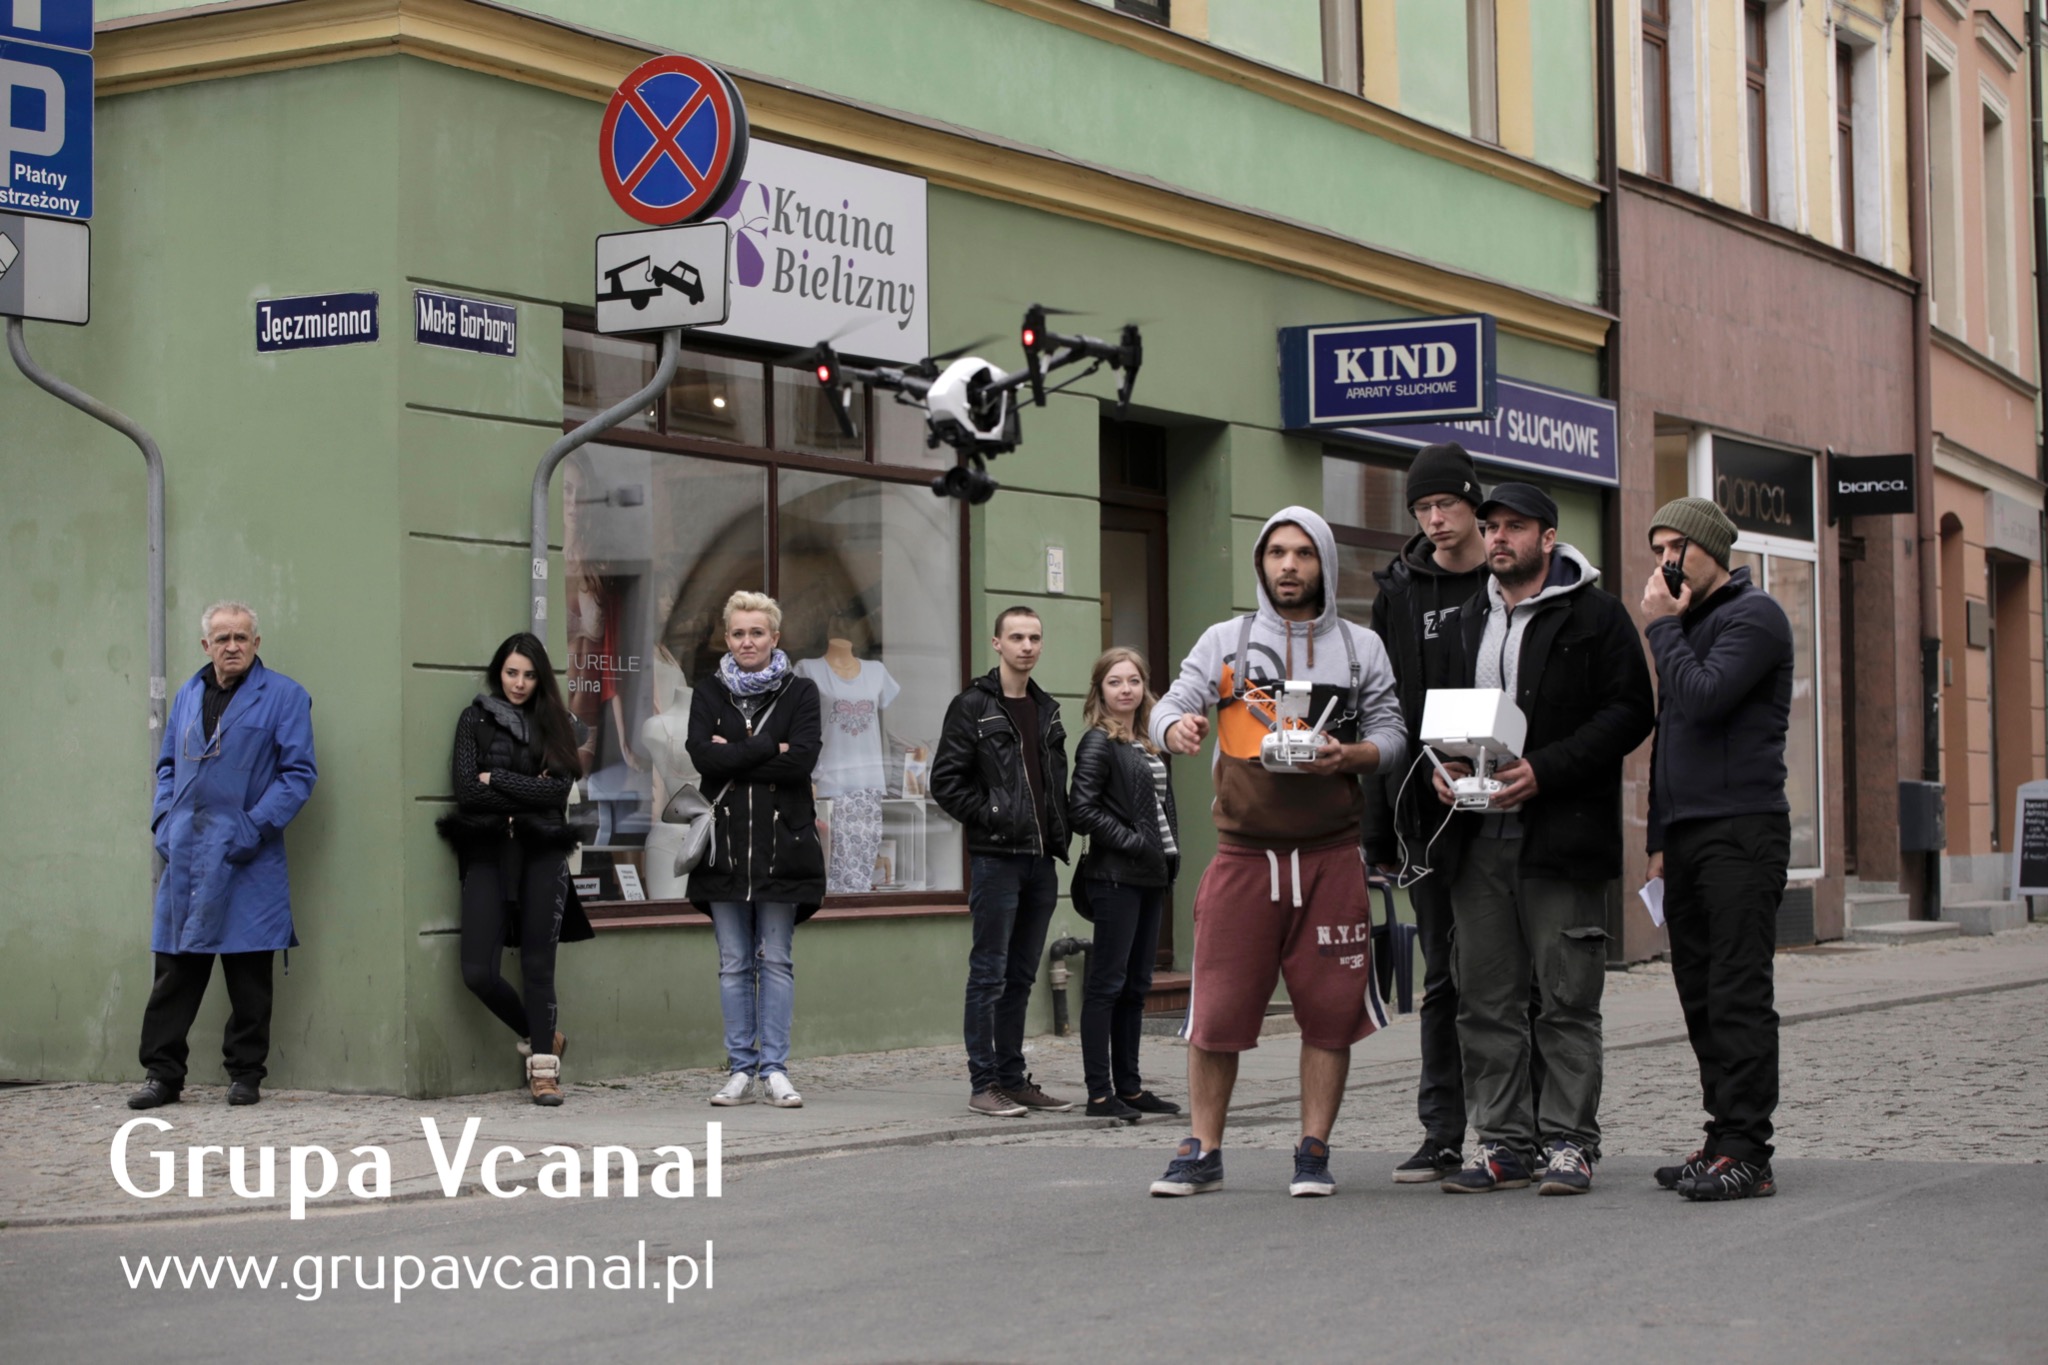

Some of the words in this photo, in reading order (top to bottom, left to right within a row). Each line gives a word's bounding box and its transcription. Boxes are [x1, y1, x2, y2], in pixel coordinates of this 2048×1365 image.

[14, 163, 68, 191] Płatny
[772, 187, 895, 256] Kraina
[772, 247, 915, 330] Bielizny
[261, 301, 371, 345] Jęczmienna
[419, 297, 456, 336] Małe
[460, 304, 515, 353] Garbary
[1334, 342, 1457, 384] KIND
[1345, 384, 1391, 400] APARATY
[1395, 381, 1457, 397] SŁUCHOWE
[1508, 408, 1599, 459] SŁUCHOWE
